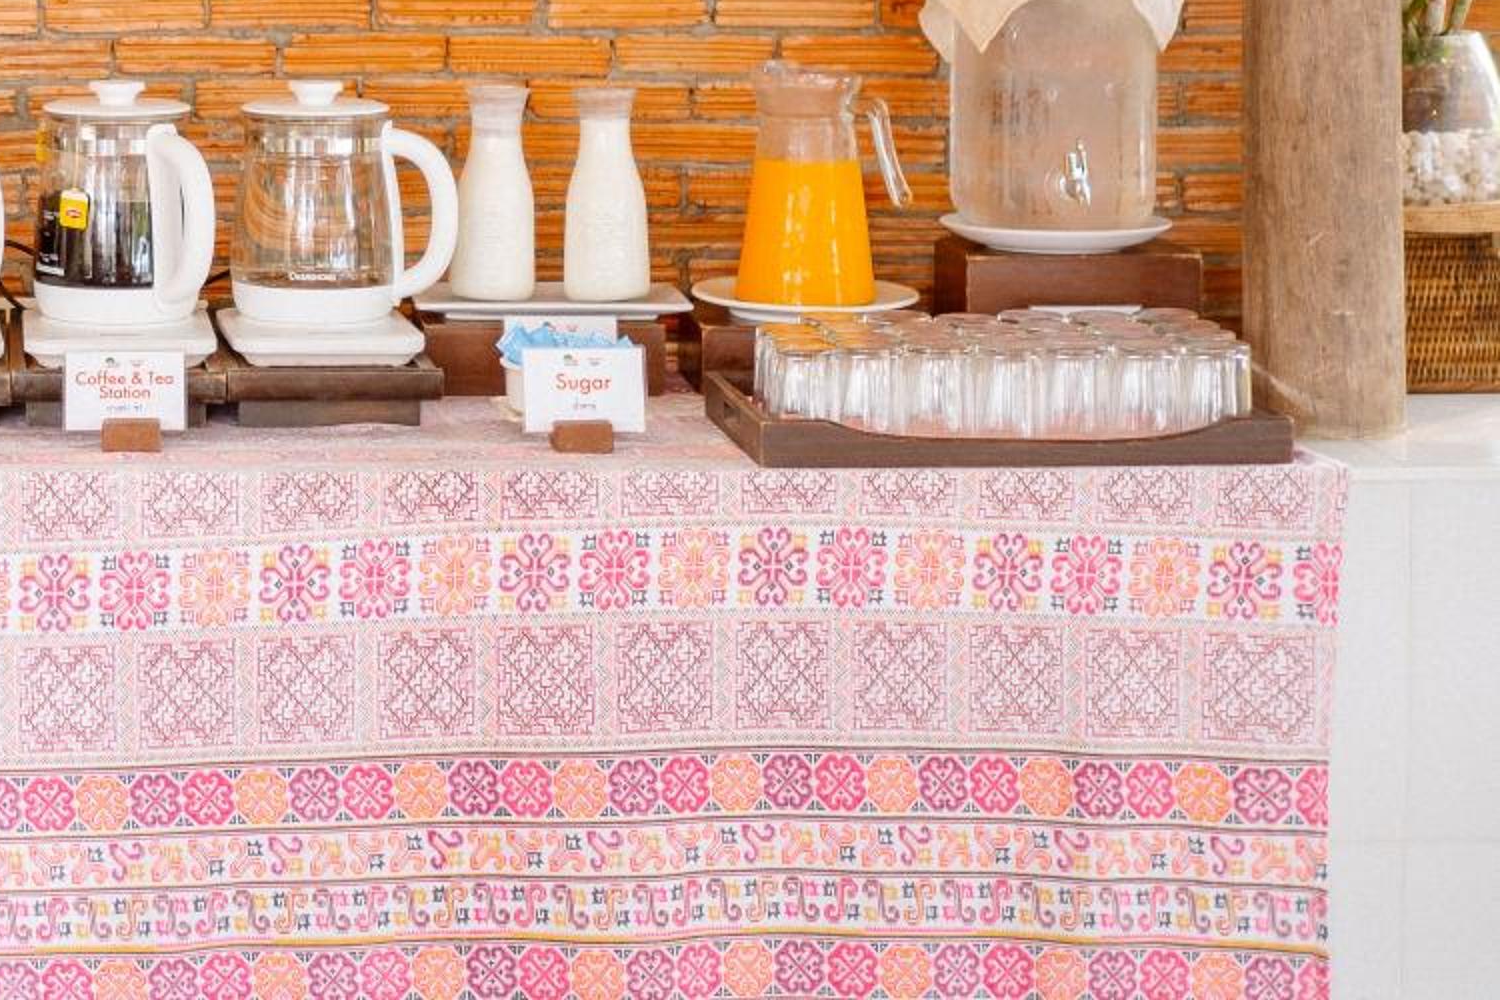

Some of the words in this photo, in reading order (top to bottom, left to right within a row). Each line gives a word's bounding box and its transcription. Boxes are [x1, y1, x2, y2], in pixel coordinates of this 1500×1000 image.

[75, 370, 126, 386] Coffee
[131, 371, 143, 385] &
[148, 371, 175, 385] Tea
[556, 373, 612, 395] Sugar
[99, 386, 152, 400] Station
